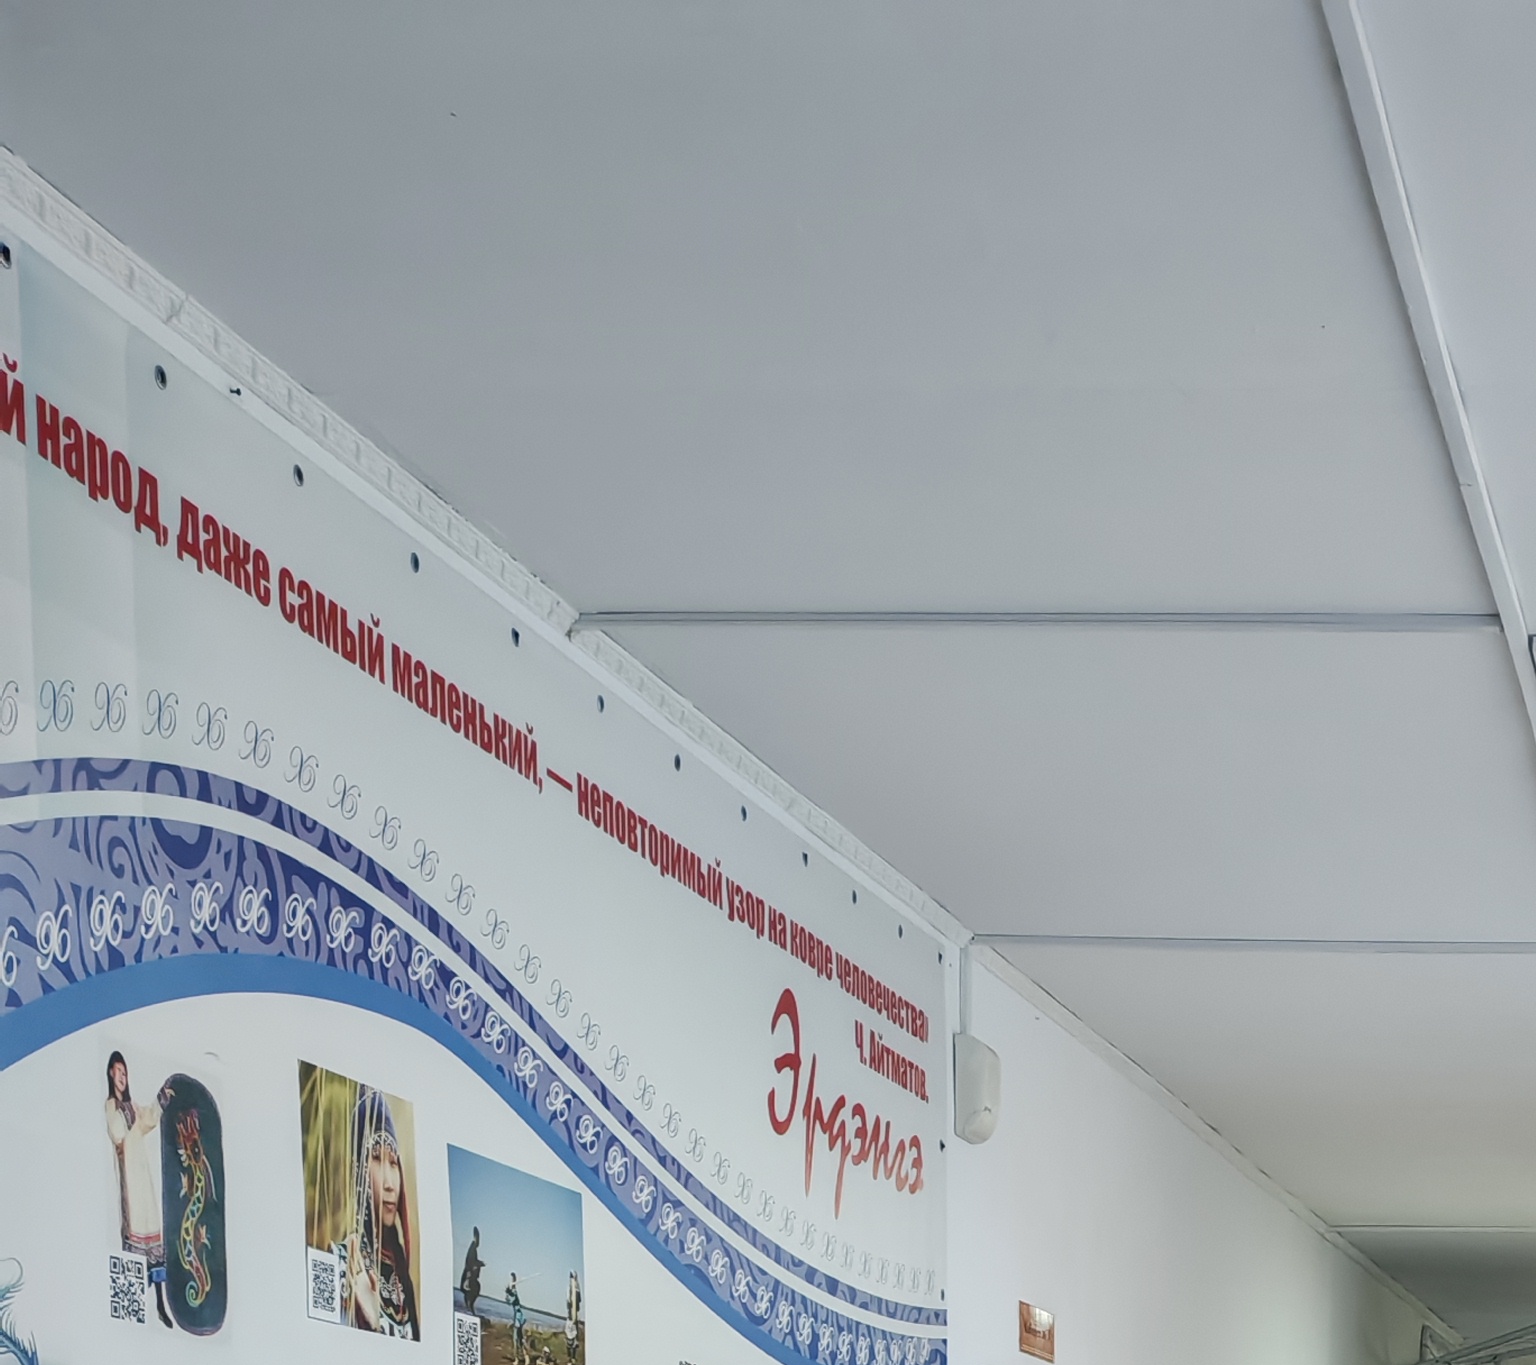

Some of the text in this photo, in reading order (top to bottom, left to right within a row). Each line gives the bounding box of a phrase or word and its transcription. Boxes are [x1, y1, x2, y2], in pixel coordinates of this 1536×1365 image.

[37, 394, 169, 547] народ,
[177, 497, 272, 607] даже
[279, 567, 386, 683] самый
[392, 642, 544, 793] маленький,
[577, 774, 723, 911] неповторимый
[726, 877, 766, 937] узор
[768, 901, 787, 950] на
[789, 917, 834, 980] ковре
[854, 1019, 929, 1104] Ч. Айтматов.
